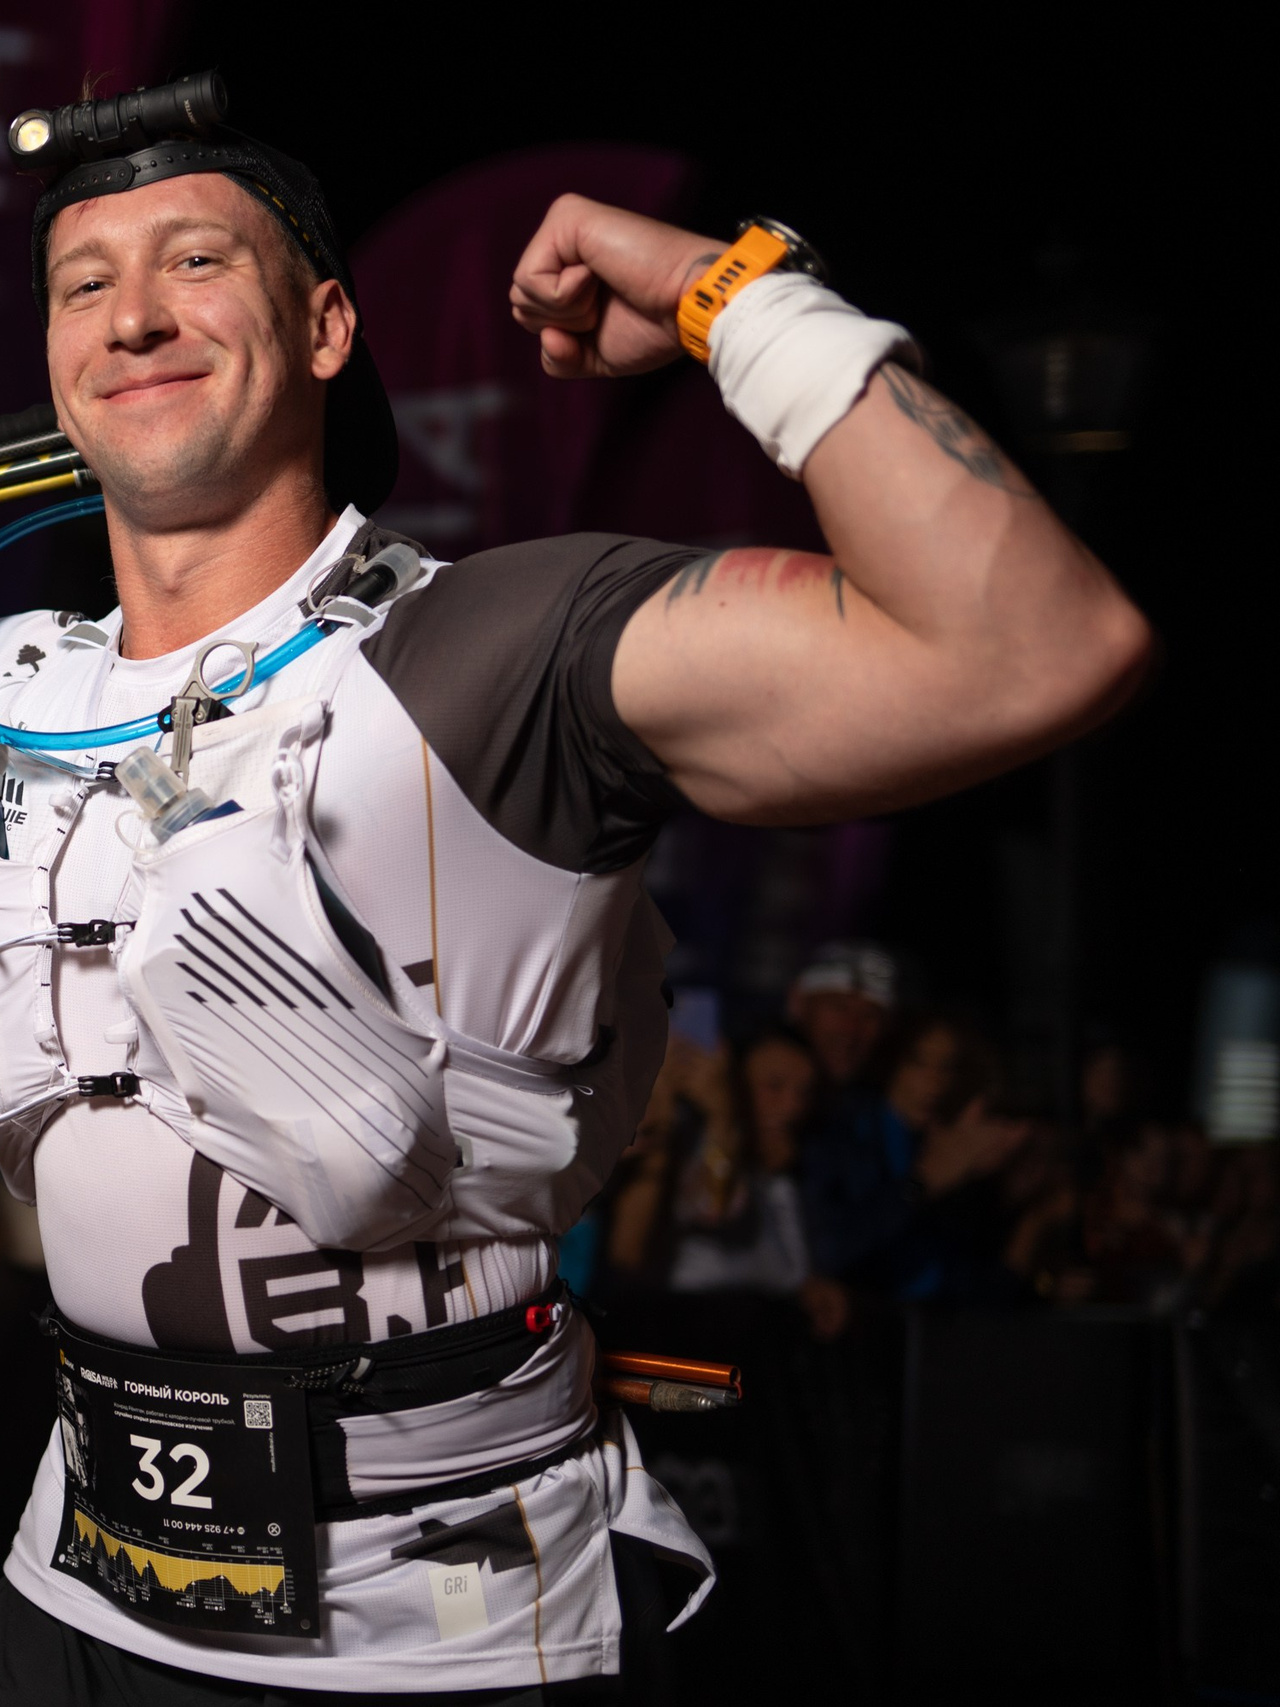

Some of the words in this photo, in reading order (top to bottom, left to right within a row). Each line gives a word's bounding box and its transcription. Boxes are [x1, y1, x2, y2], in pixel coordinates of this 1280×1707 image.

[124, 1380, 172, 1400] ГОРНЫЙ
[174, 1389, 230, 1406] КОРОЛЬ
[129, 1433, 213, 1510] 32
[163, 1518, 170, 1528] 11
[171, 1520, 184, 1529] 00
[185, 1522, 203, 1532] 444
[204, 1524, 222, 1534] 925
[223, 1525, 235, 1535] +7
